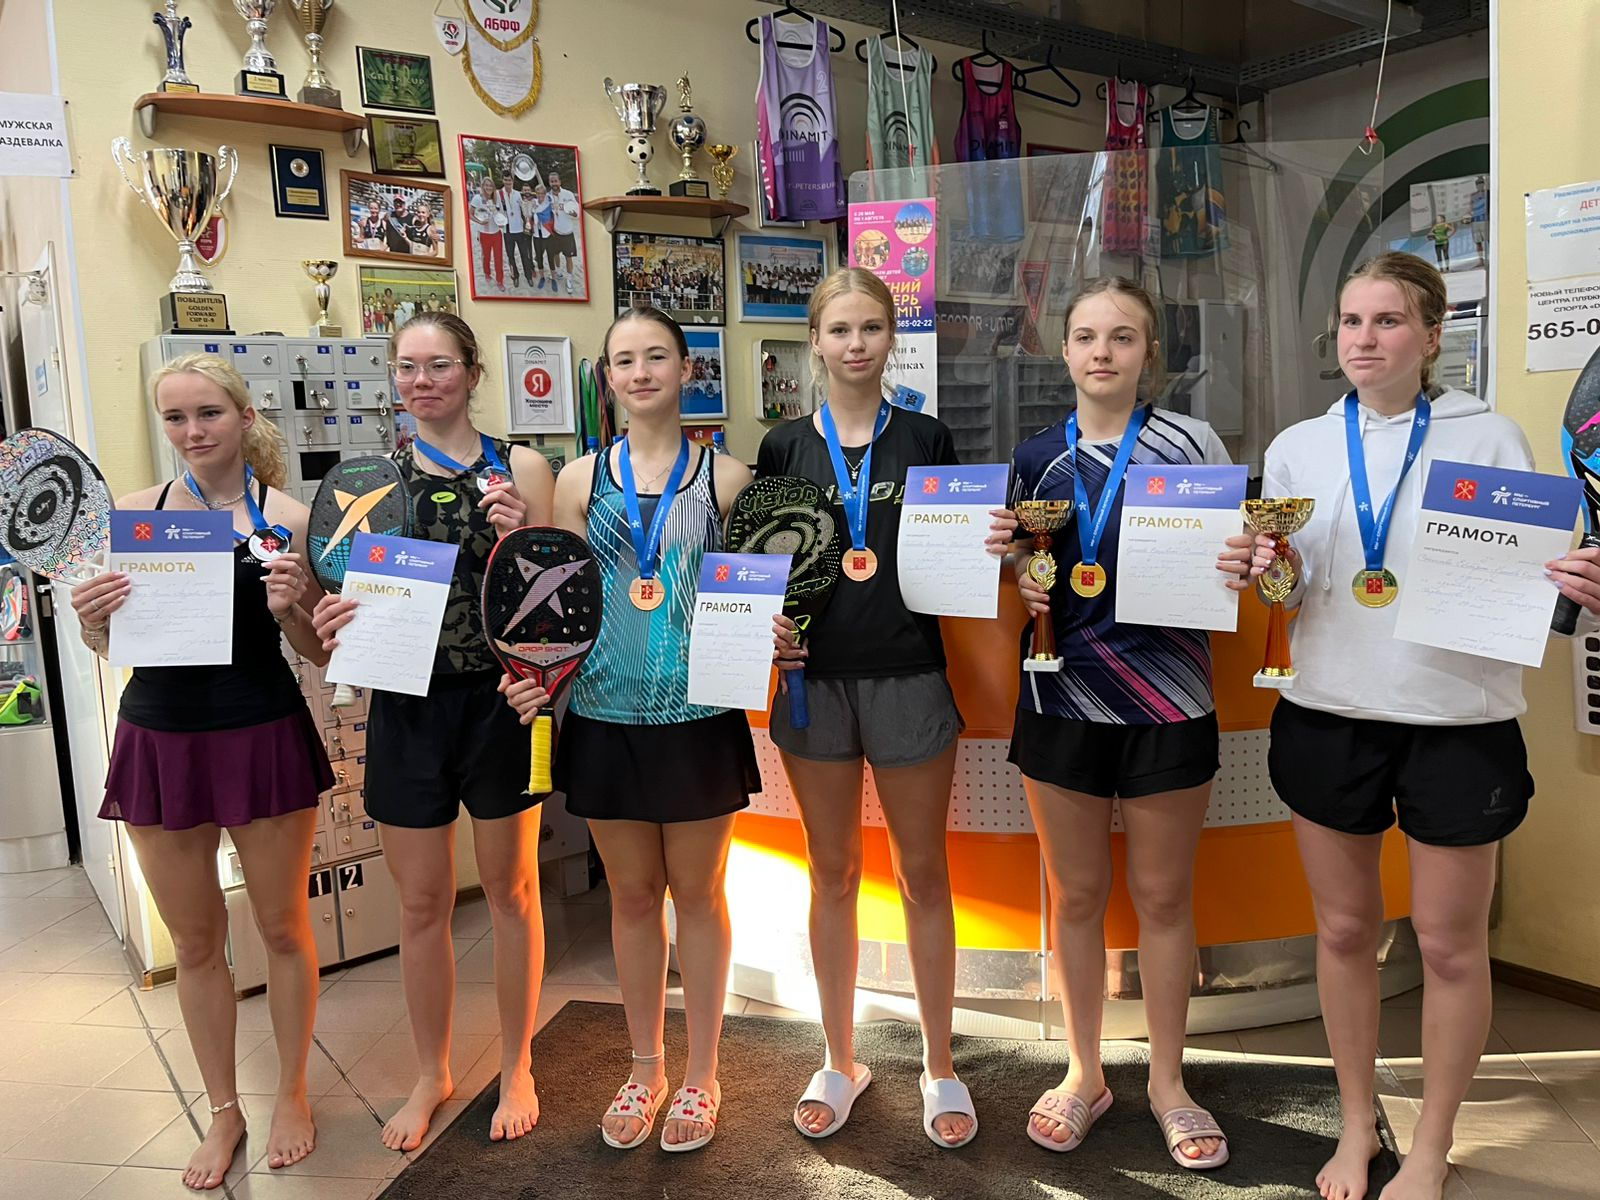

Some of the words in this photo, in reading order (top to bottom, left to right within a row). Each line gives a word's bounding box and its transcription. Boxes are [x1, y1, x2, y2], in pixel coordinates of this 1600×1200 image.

[484, 17, 520, 33] АБФФ
[816, 71, 828, 91] 2
[0, 120, 53, 130] МУЖСКАЯ
[0, 137, 63, 147] АЗДЕВАЛКА
[1580, 199, 1600, 211] ДЕТ
[1530, 289, 1563, 298] НОВЫЙ
[1537, 298, 1570, 306] ЦЕНТРА
[1553, 304, 1588, 313] СПОРТА
[894, 305, 922, 318] MIT
[532, 373, 544, 393] Я
[907, 513, 970, 524] ГРАМОТА
[1128, 516, 1203, 529] ГРАМОТА
[1426, 521, 1519, 547] ГРАМОТА
[119, 561, 196, 573] ГРАМОТА
[349, 581, 412, 599] ГРАМОТА
[699, 601, 752, 614] ГРАМОТА
[315, 872, 324, 896] 1
[344, 865, 359, 890] 2
